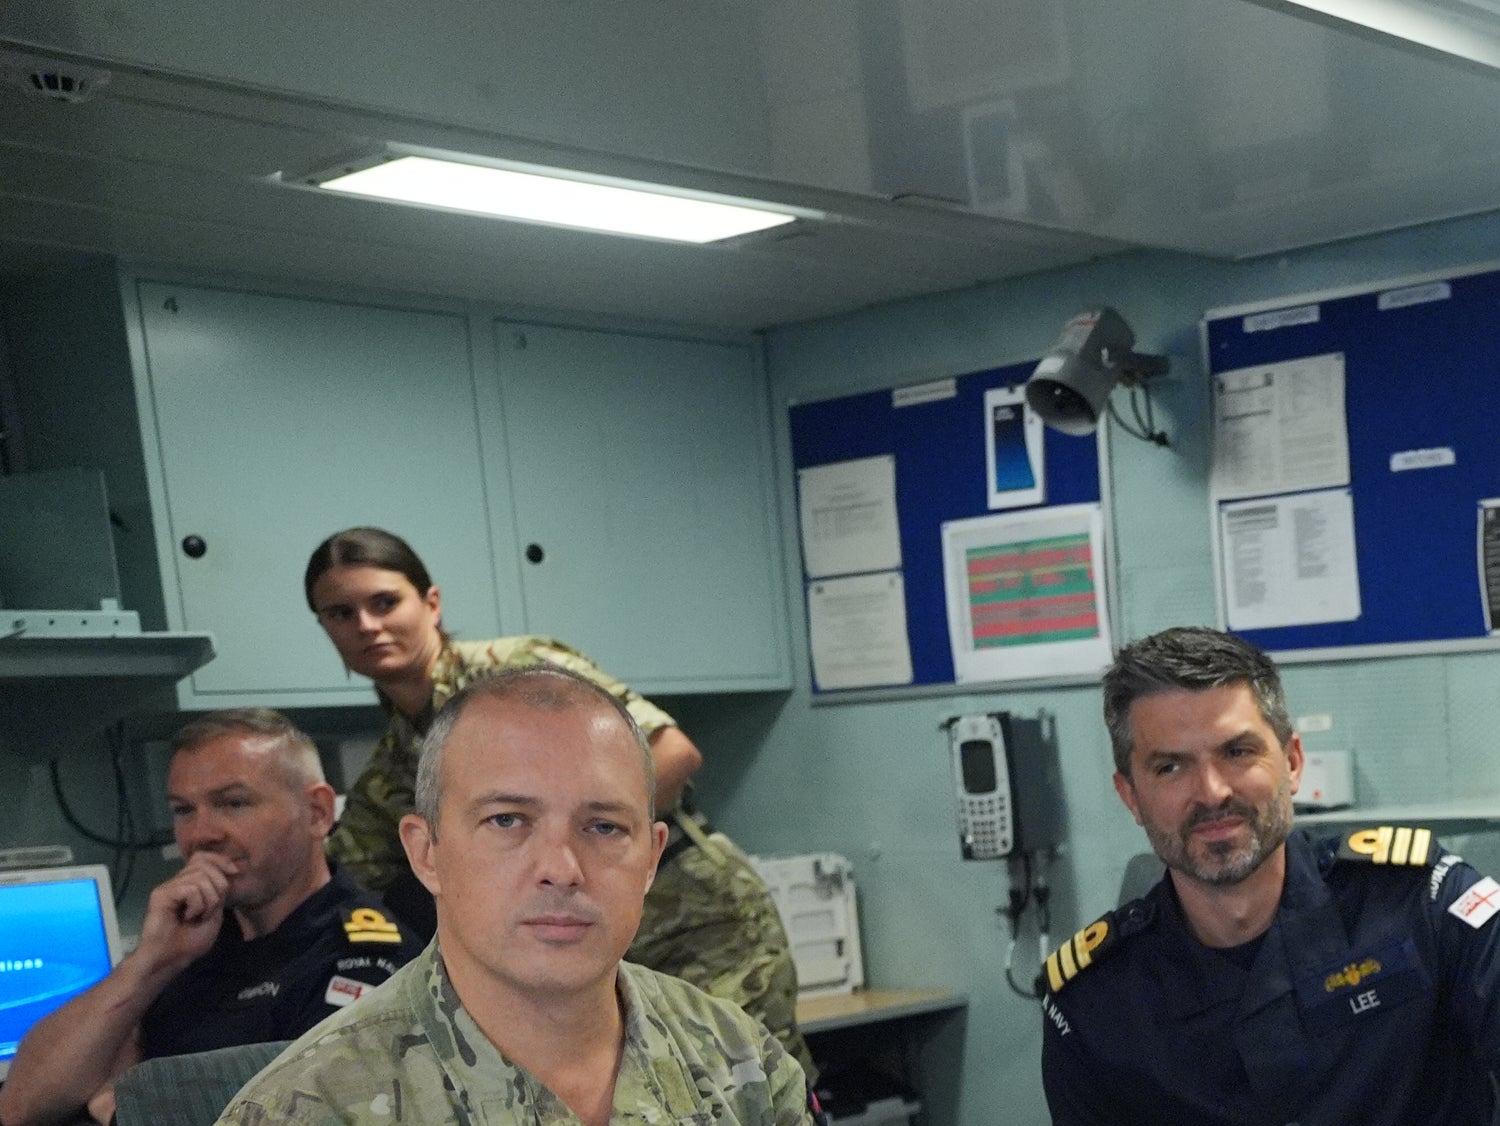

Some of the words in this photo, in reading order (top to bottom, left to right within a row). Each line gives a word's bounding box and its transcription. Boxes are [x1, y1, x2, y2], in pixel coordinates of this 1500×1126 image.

[337, 957, 371, 971] ROYAL
[1349, 989, 1381, 1014] LEE
[1048, 1003, 1071, 1036] NAVY
